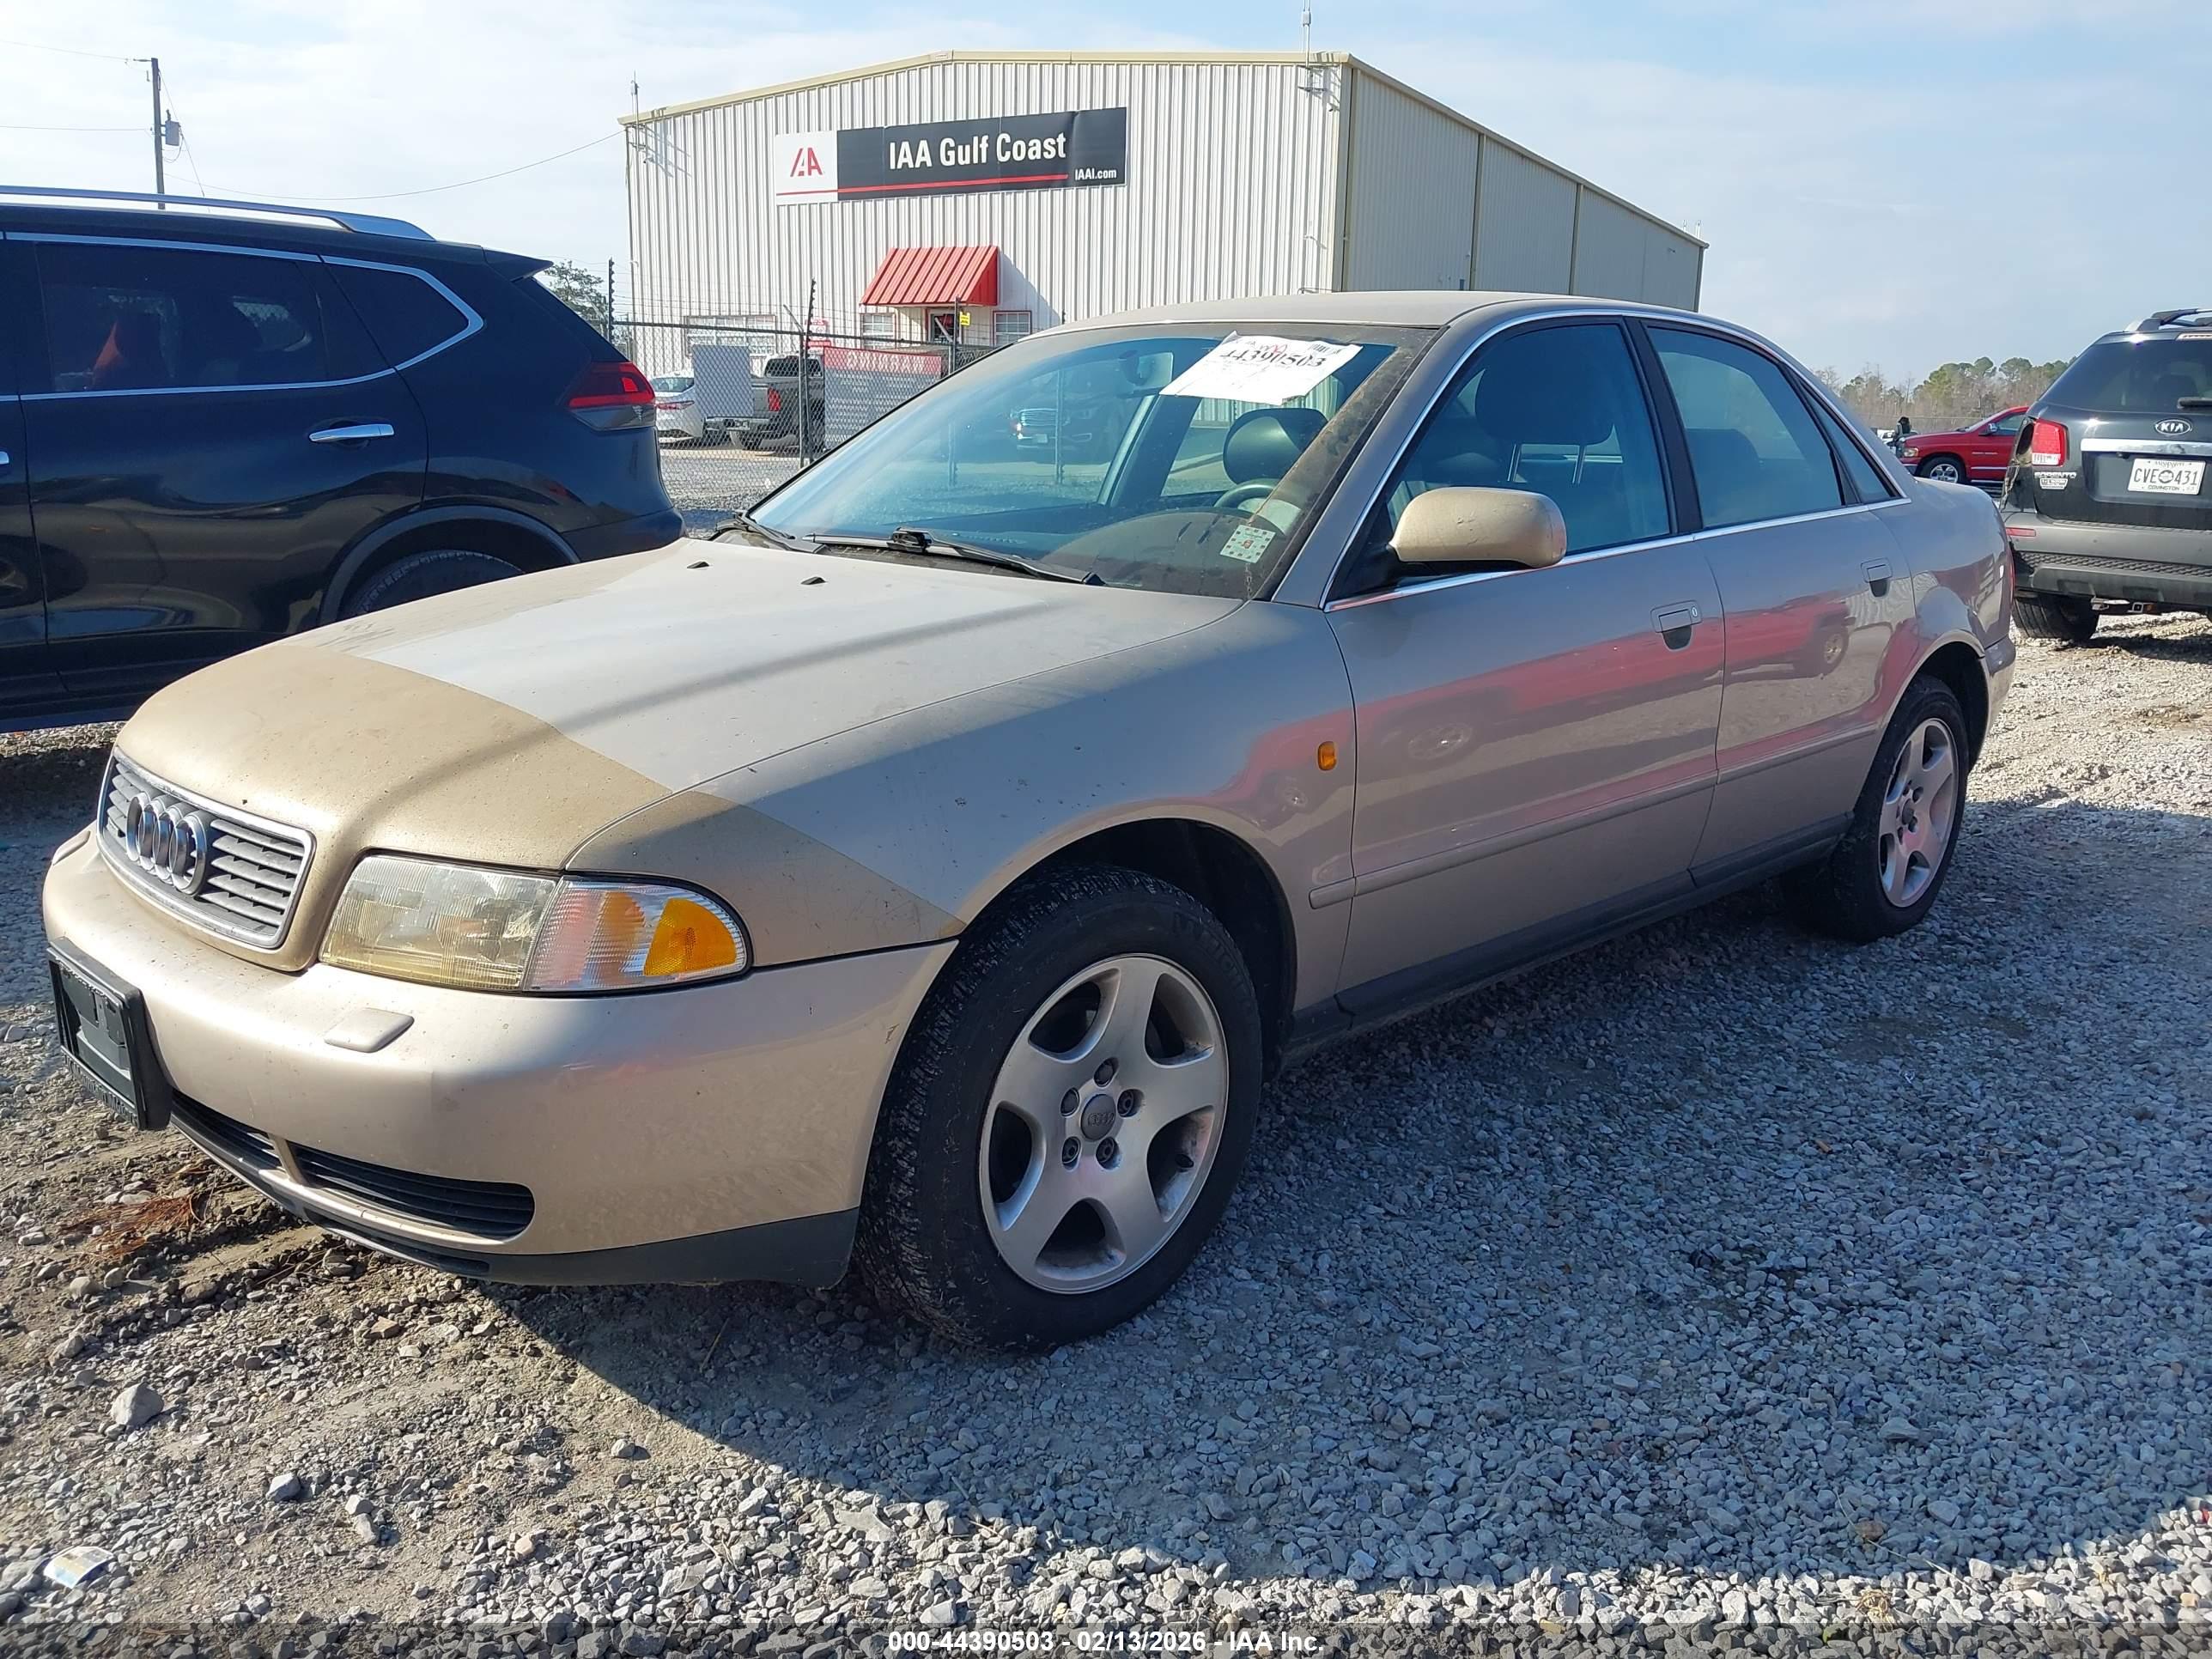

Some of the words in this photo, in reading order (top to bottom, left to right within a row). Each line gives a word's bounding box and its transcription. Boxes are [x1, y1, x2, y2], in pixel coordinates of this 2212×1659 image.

[889, 140, 933, 170] IAA
[939, 135, 989, 167] Gulf
[996, 131, 1066, 163] Coast
[1074, 167, 1118, 182] IAAI.com
[2160, 422, 2184, 432] KIA
[2133, 468, 2160, 483] CVE
[2173, 470, 2199, 486] 431
